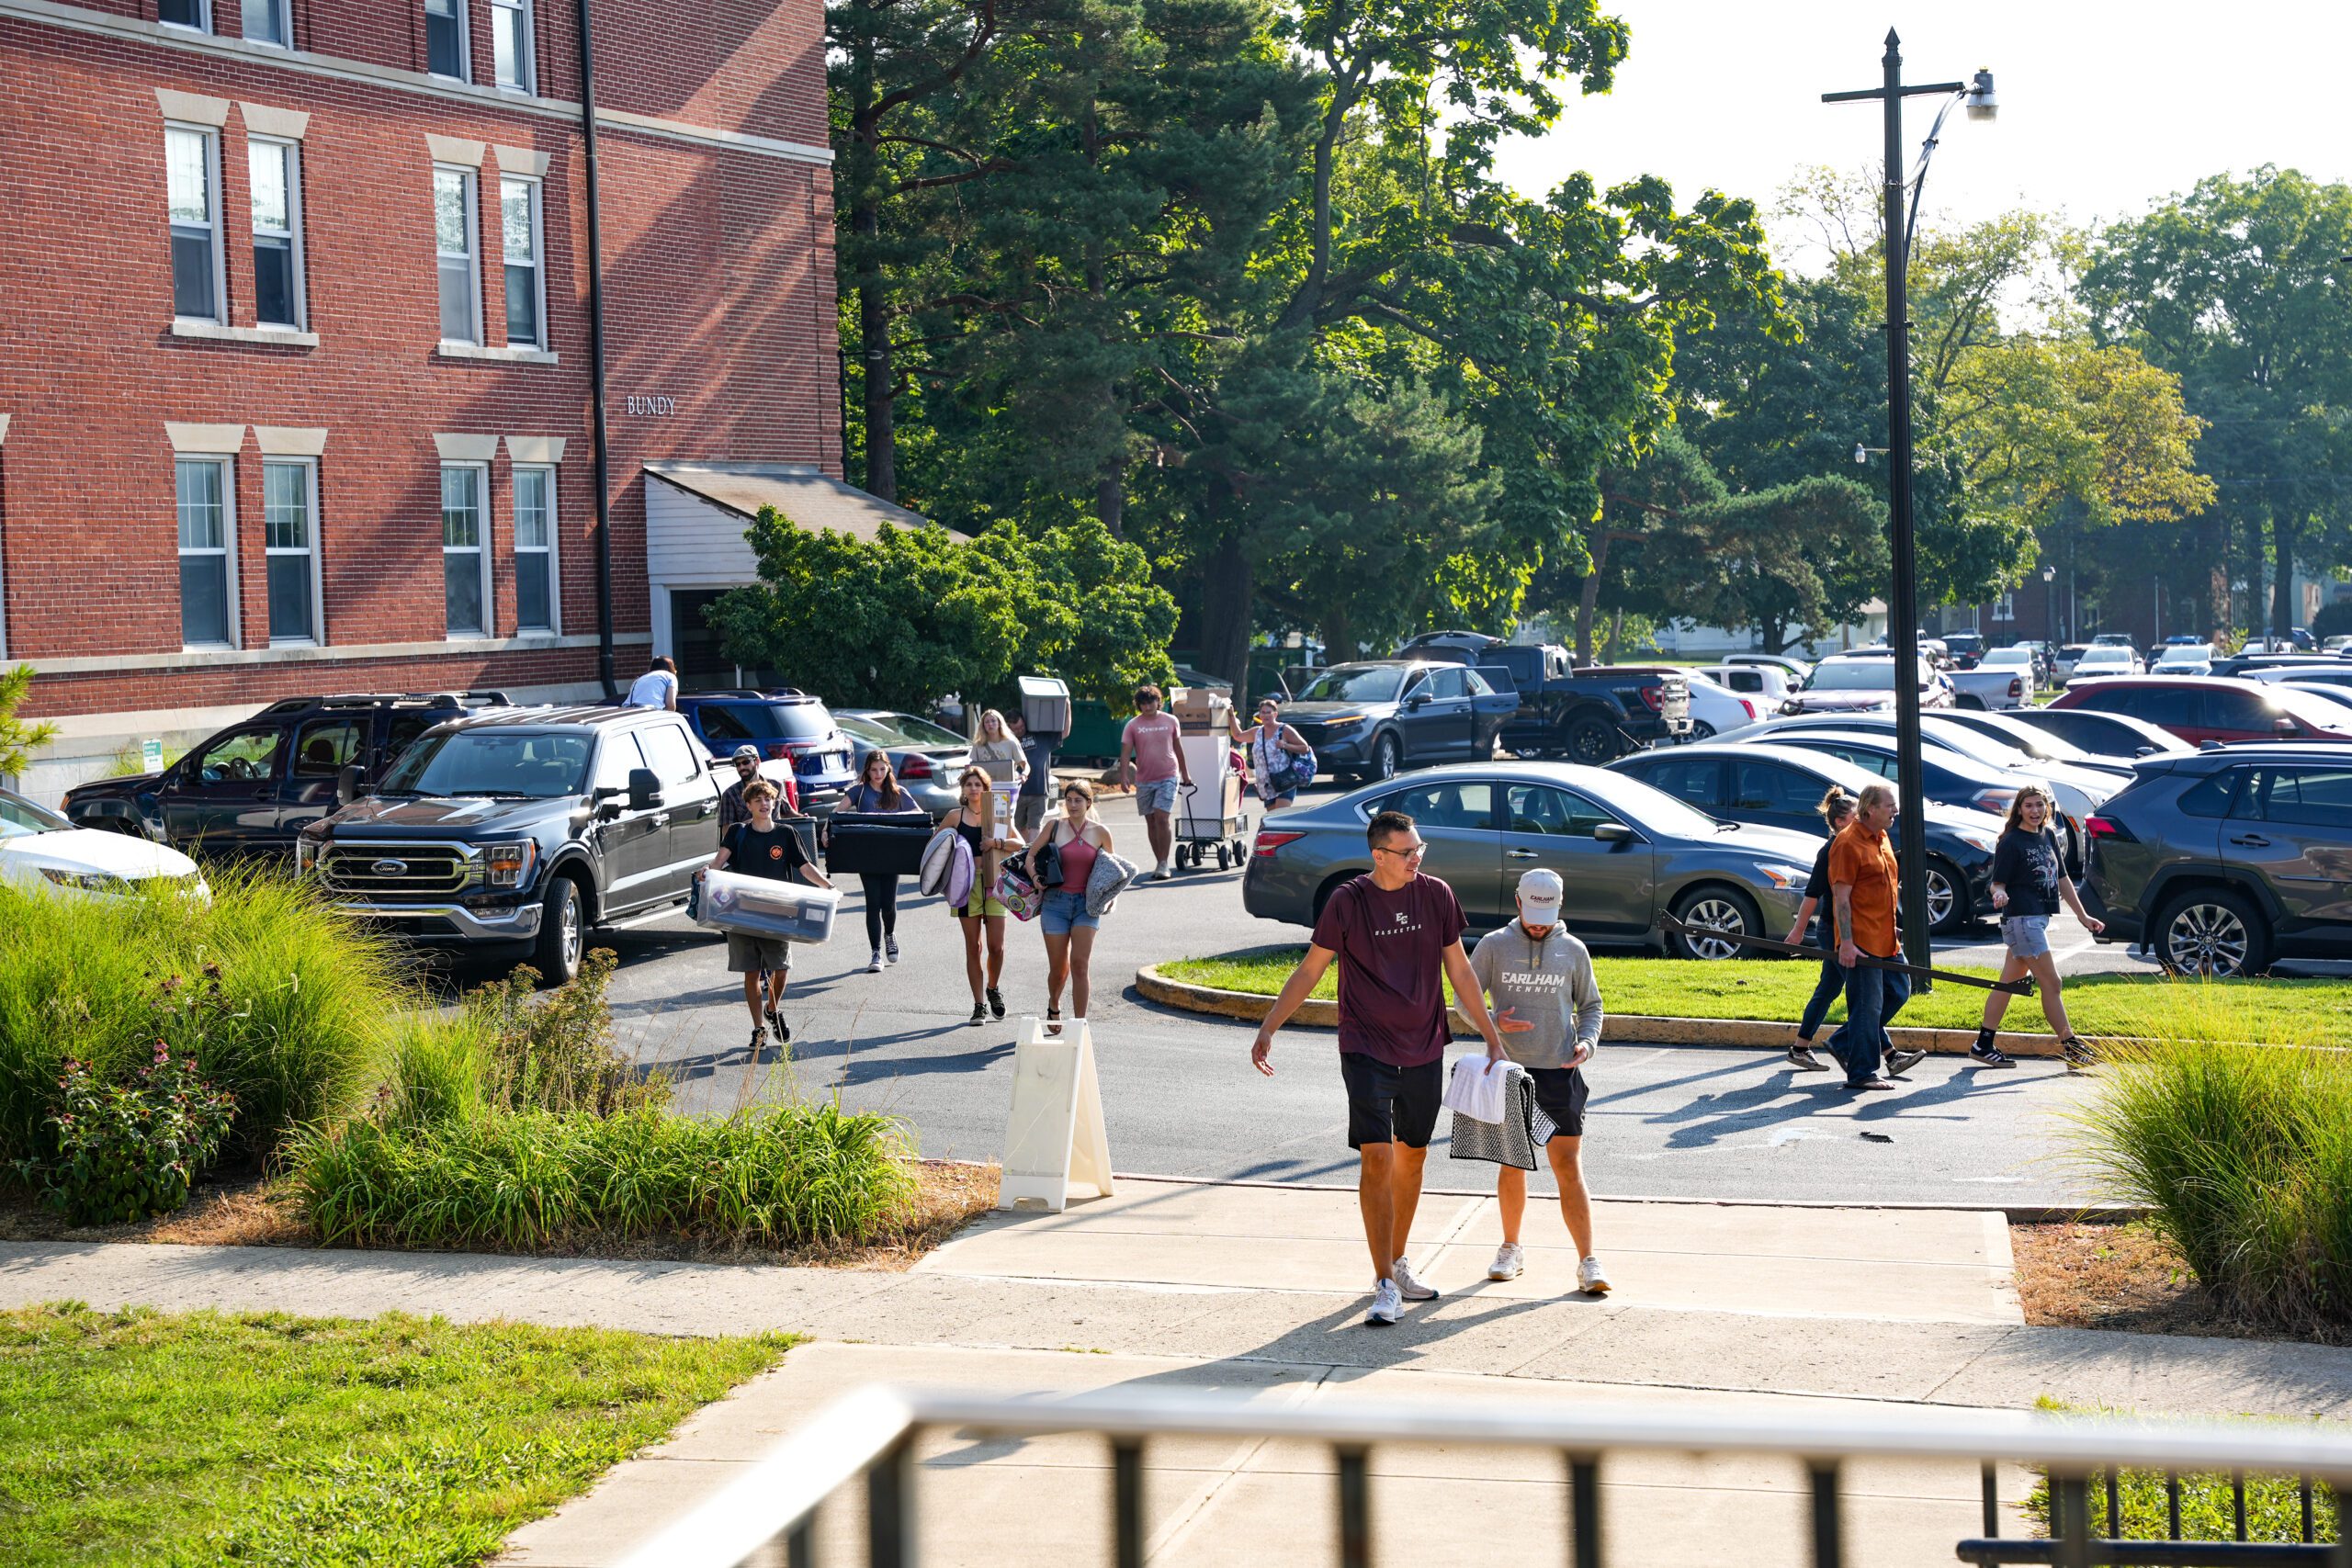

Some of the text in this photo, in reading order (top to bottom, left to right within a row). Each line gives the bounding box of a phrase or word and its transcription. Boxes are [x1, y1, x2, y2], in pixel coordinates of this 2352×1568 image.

[628, 396, 675, 414] BUNDY
[1374, 923, 1422, 936] BASKETBA
[1501, 972, 1566, 987] EARLHAM
[1508, 985, 1557, 994] TENNIS
